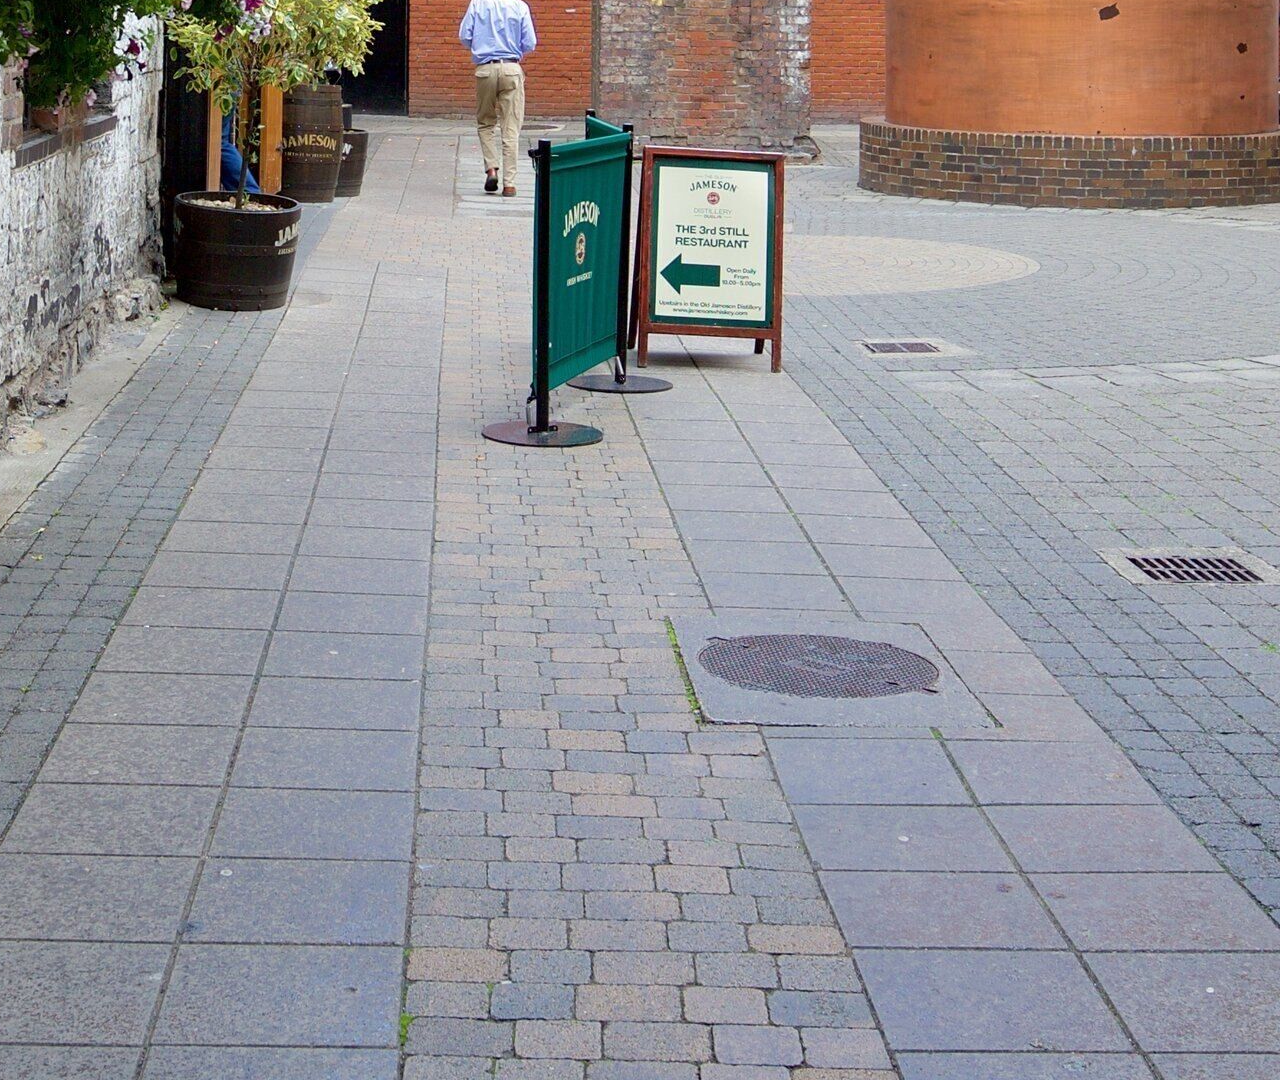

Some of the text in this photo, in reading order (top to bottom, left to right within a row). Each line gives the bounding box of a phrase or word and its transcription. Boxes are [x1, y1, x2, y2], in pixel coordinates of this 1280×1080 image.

[282, 133, 337, 151] JAMESON
[689, 180, 737, 193] JAMESON
[693, 207, 733, 215] DISTILLERY
[563, 201, 599, 237] JAMESON
[676, 225, 749, 237] THE 3rd STILL
[675, 237, 749, 249] RESTAURANT
[726, 267, 757, 275] Open Daily
[737, 303, 762, 311] Distillery
